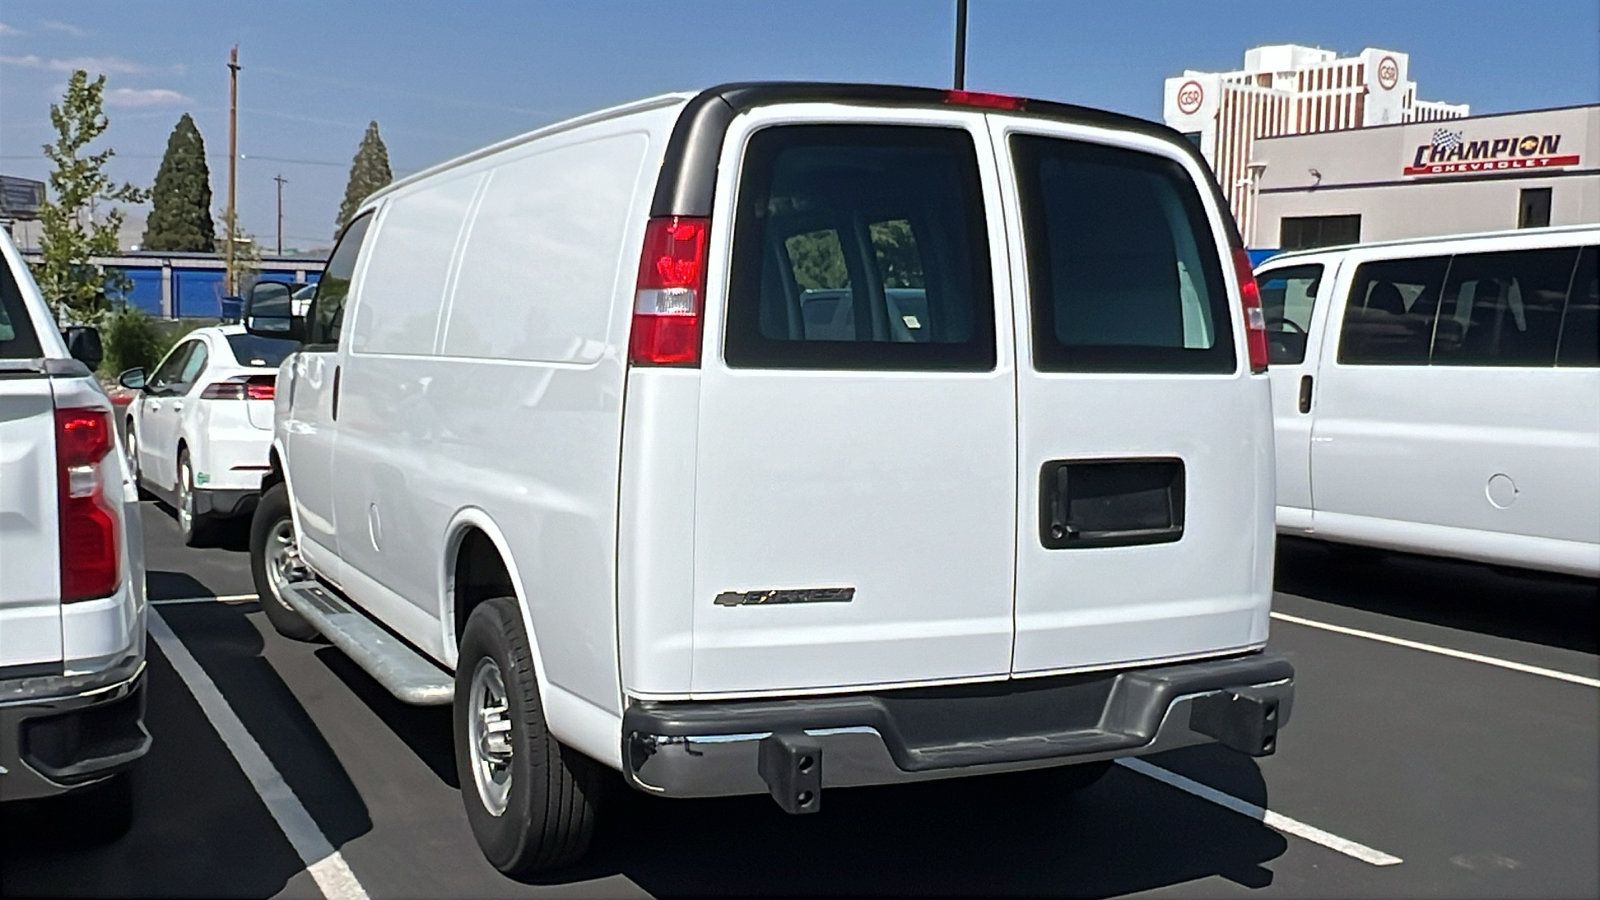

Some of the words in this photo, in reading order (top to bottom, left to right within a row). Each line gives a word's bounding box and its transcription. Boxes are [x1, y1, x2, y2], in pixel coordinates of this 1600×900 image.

[1380, 65, 1397, 82] GSR
[1180, 90, 1201, 106] GSR
[1412, 134, 1562, 168] CHAMPION
[1431, 158, 1551, 173] CHEVROLET
